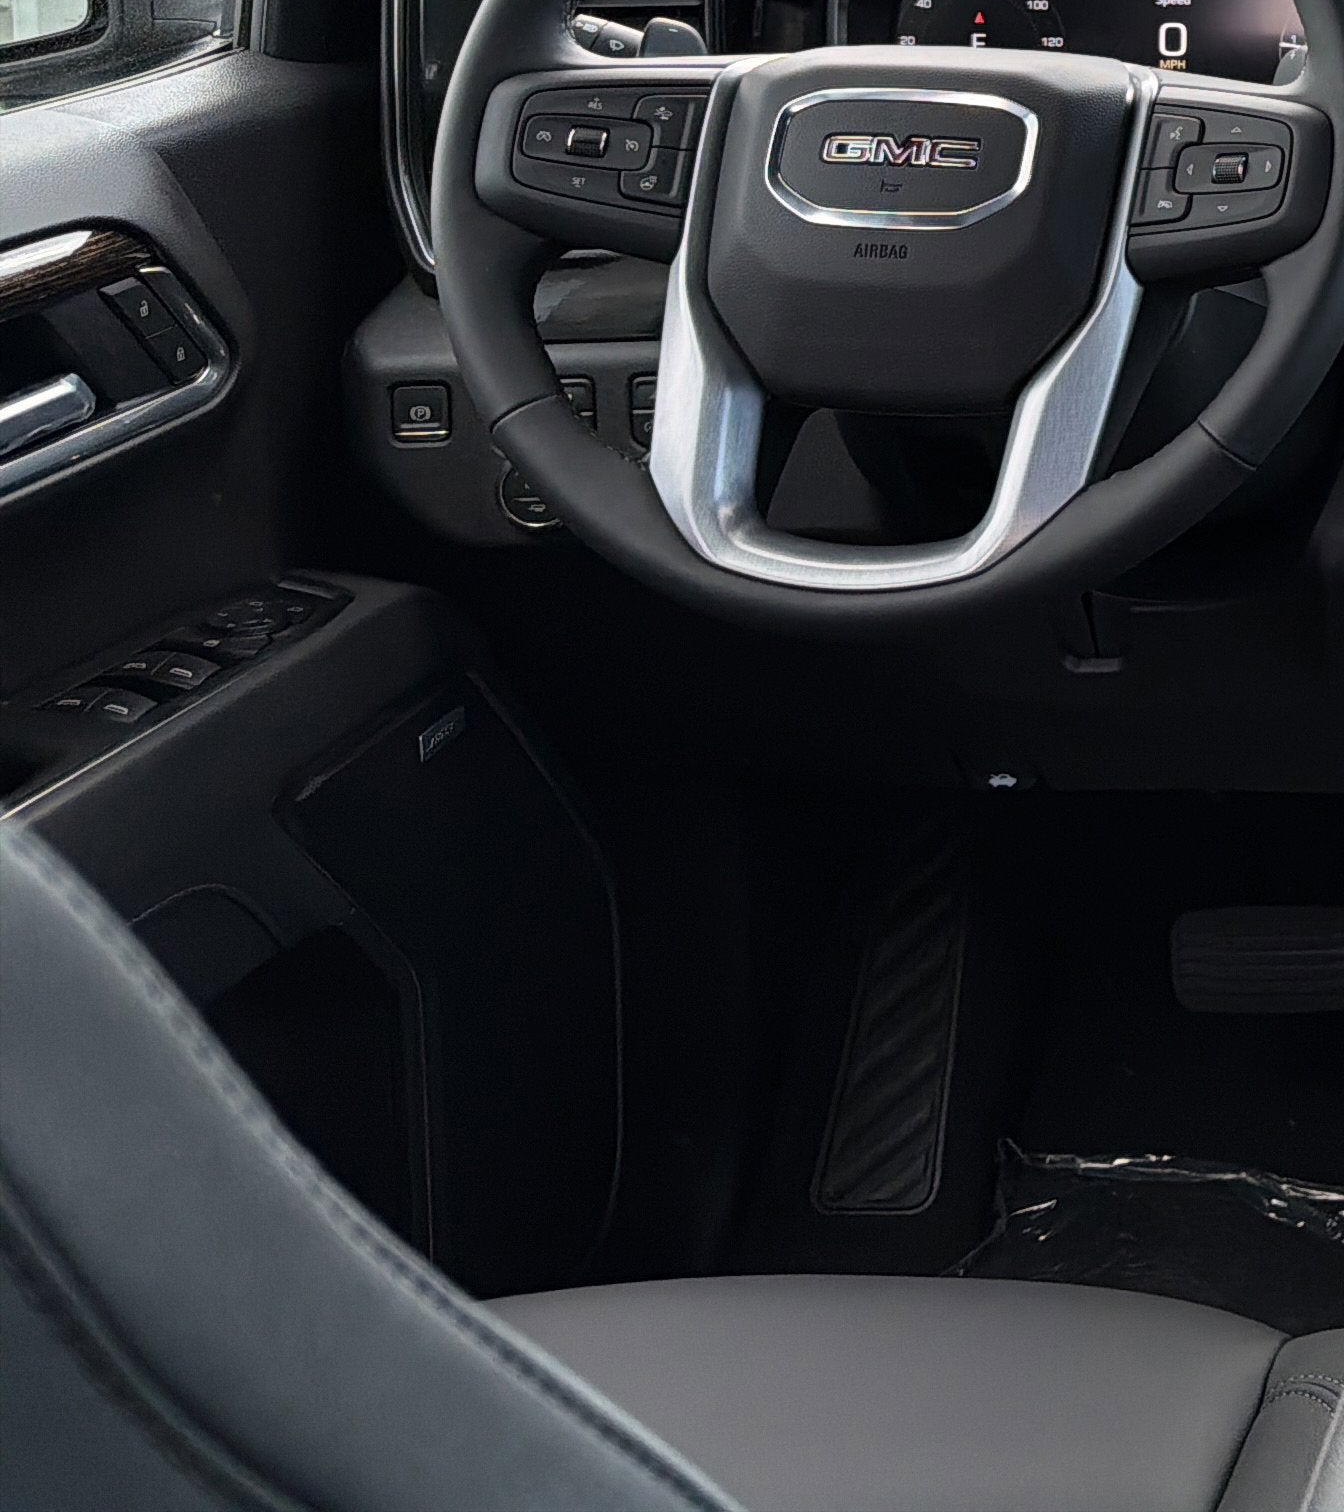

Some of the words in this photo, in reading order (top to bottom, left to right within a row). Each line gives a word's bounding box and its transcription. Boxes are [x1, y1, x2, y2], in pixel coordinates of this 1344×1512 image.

[1026, 0, 1049, 10] 100
[899, 36, 916, 46] 20
[1041, 37, 1064, 48] 120
[1158, 22, 1188, 57] 0
[1159, 60, 1187, 69] MPH
[822, 135, 980, 168] GMC
[572, 177, 586, 186] SET
[853, 244, 909, 260] AIRBAG
